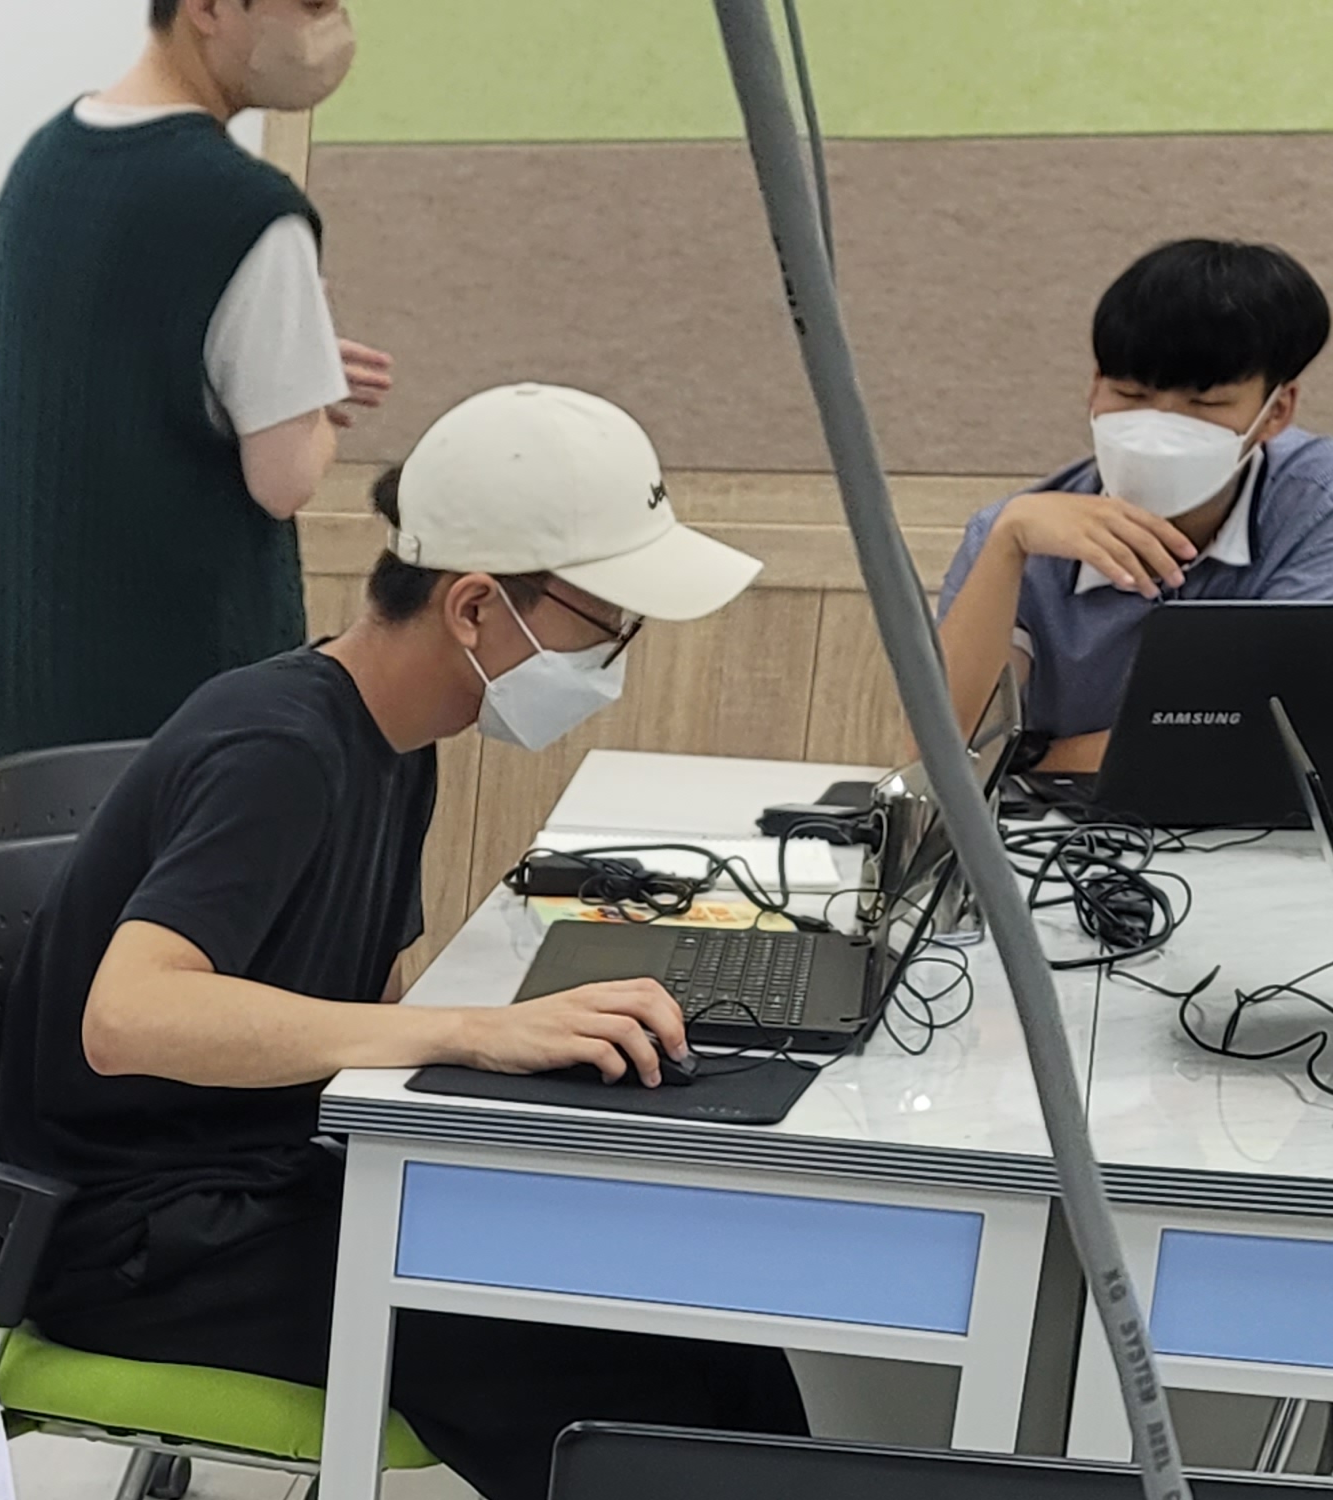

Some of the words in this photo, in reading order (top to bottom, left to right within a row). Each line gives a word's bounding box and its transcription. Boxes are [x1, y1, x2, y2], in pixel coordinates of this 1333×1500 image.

[1151, 711, 1242, 725] SAMSUNG
[1119, 1319, 1158, 1405] SYSTEM
[1146, 1420, 1171, 1474] REEL
